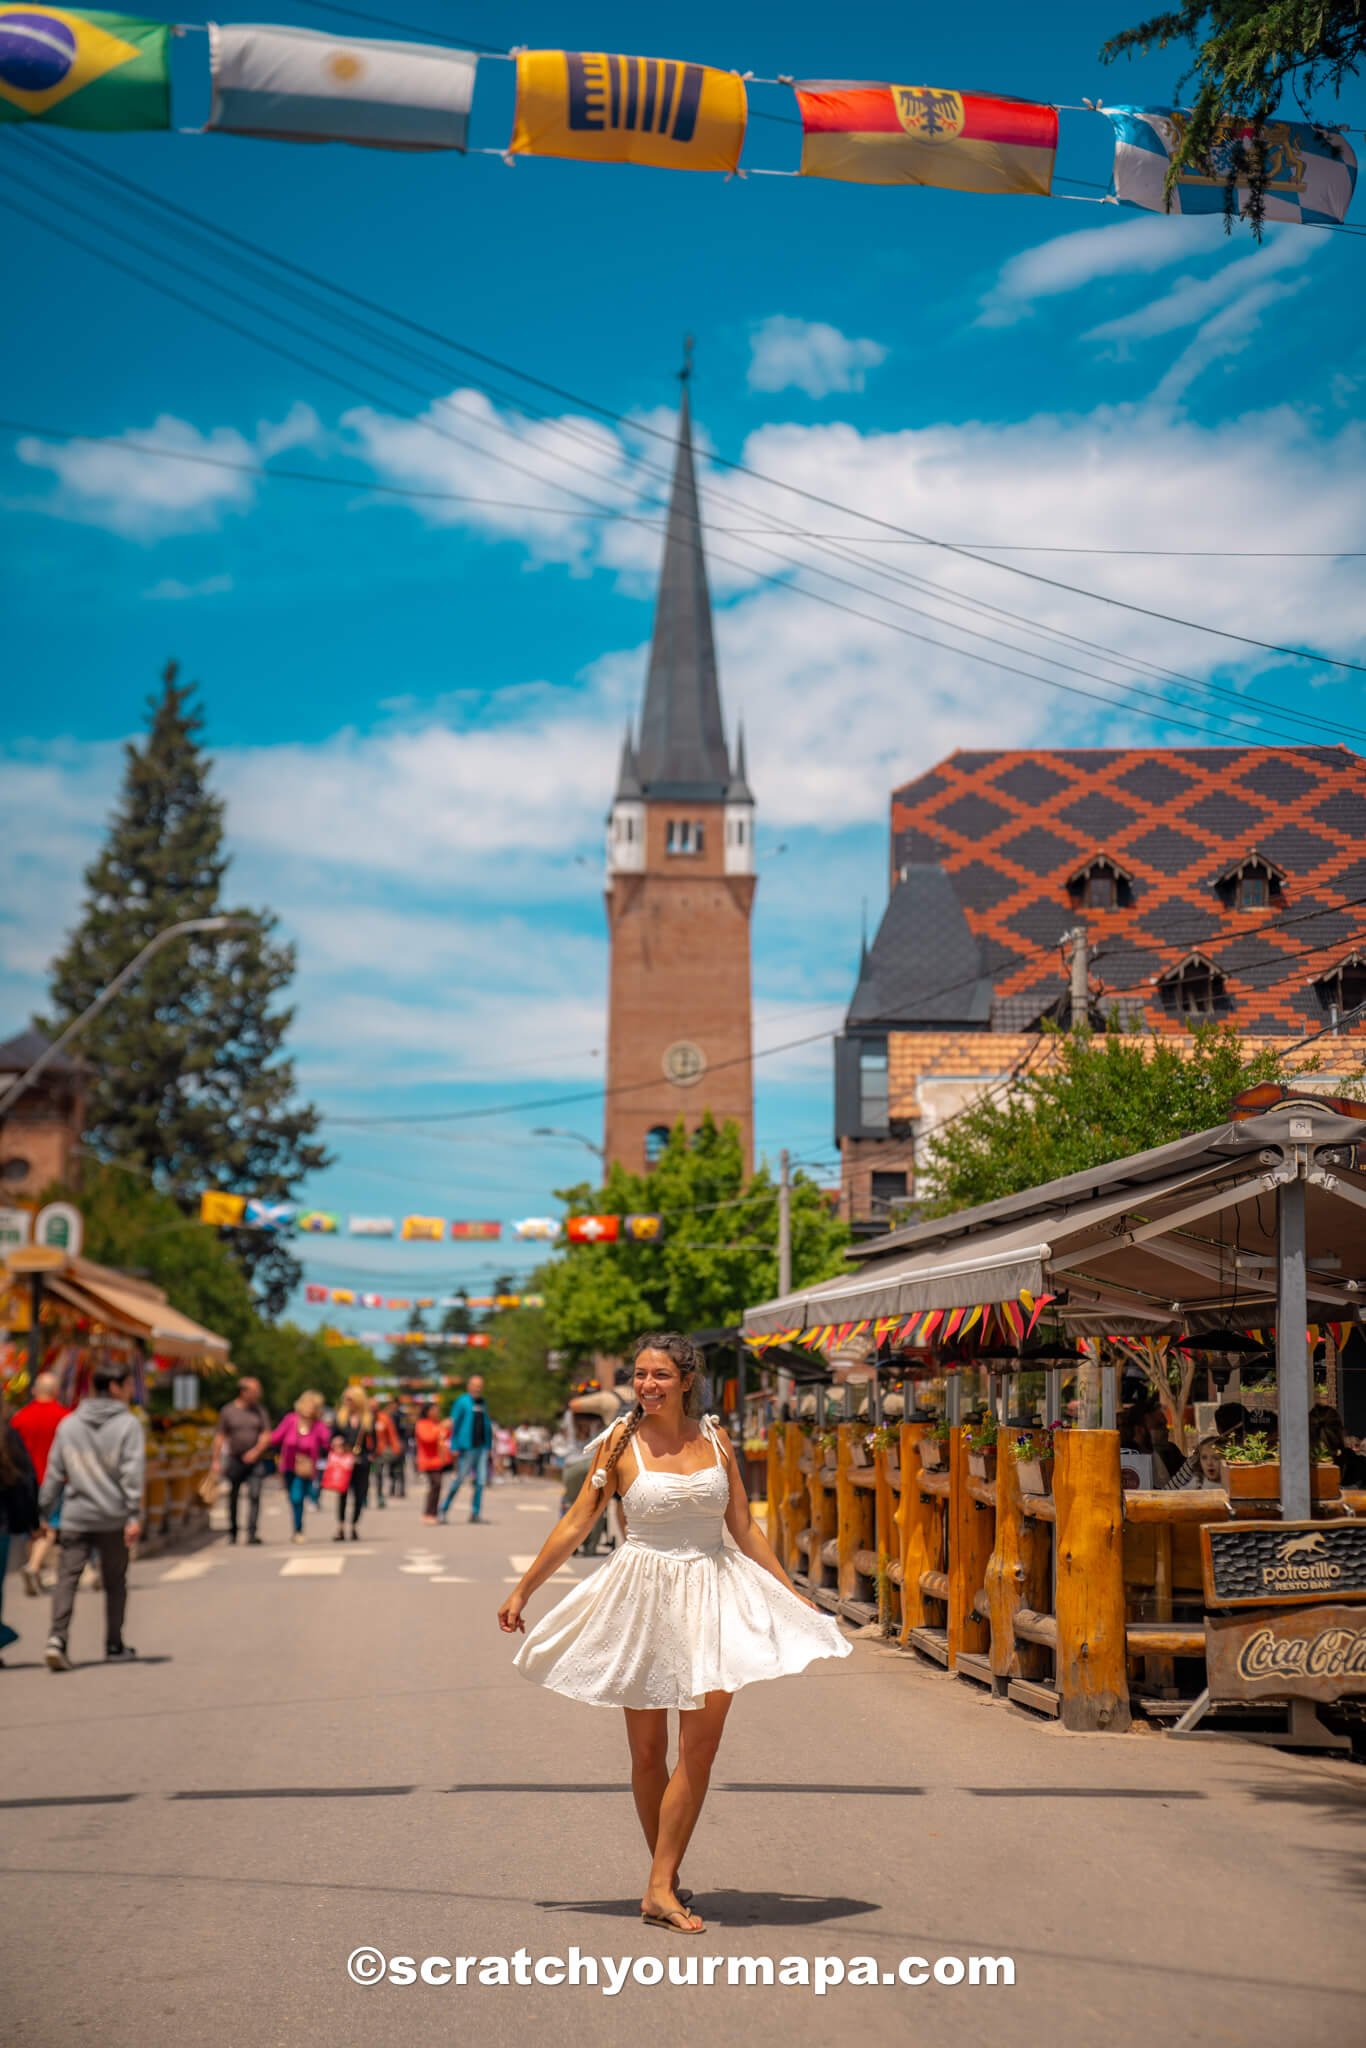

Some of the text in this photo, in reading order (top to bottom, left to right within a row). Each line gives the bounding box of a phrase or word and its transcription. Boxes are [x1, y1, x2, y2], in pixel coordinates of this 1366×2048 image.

[1262, 1561, 1341, 1585] potrerillo
[1275, 1581, 1331, 1591] RESTO BAR
